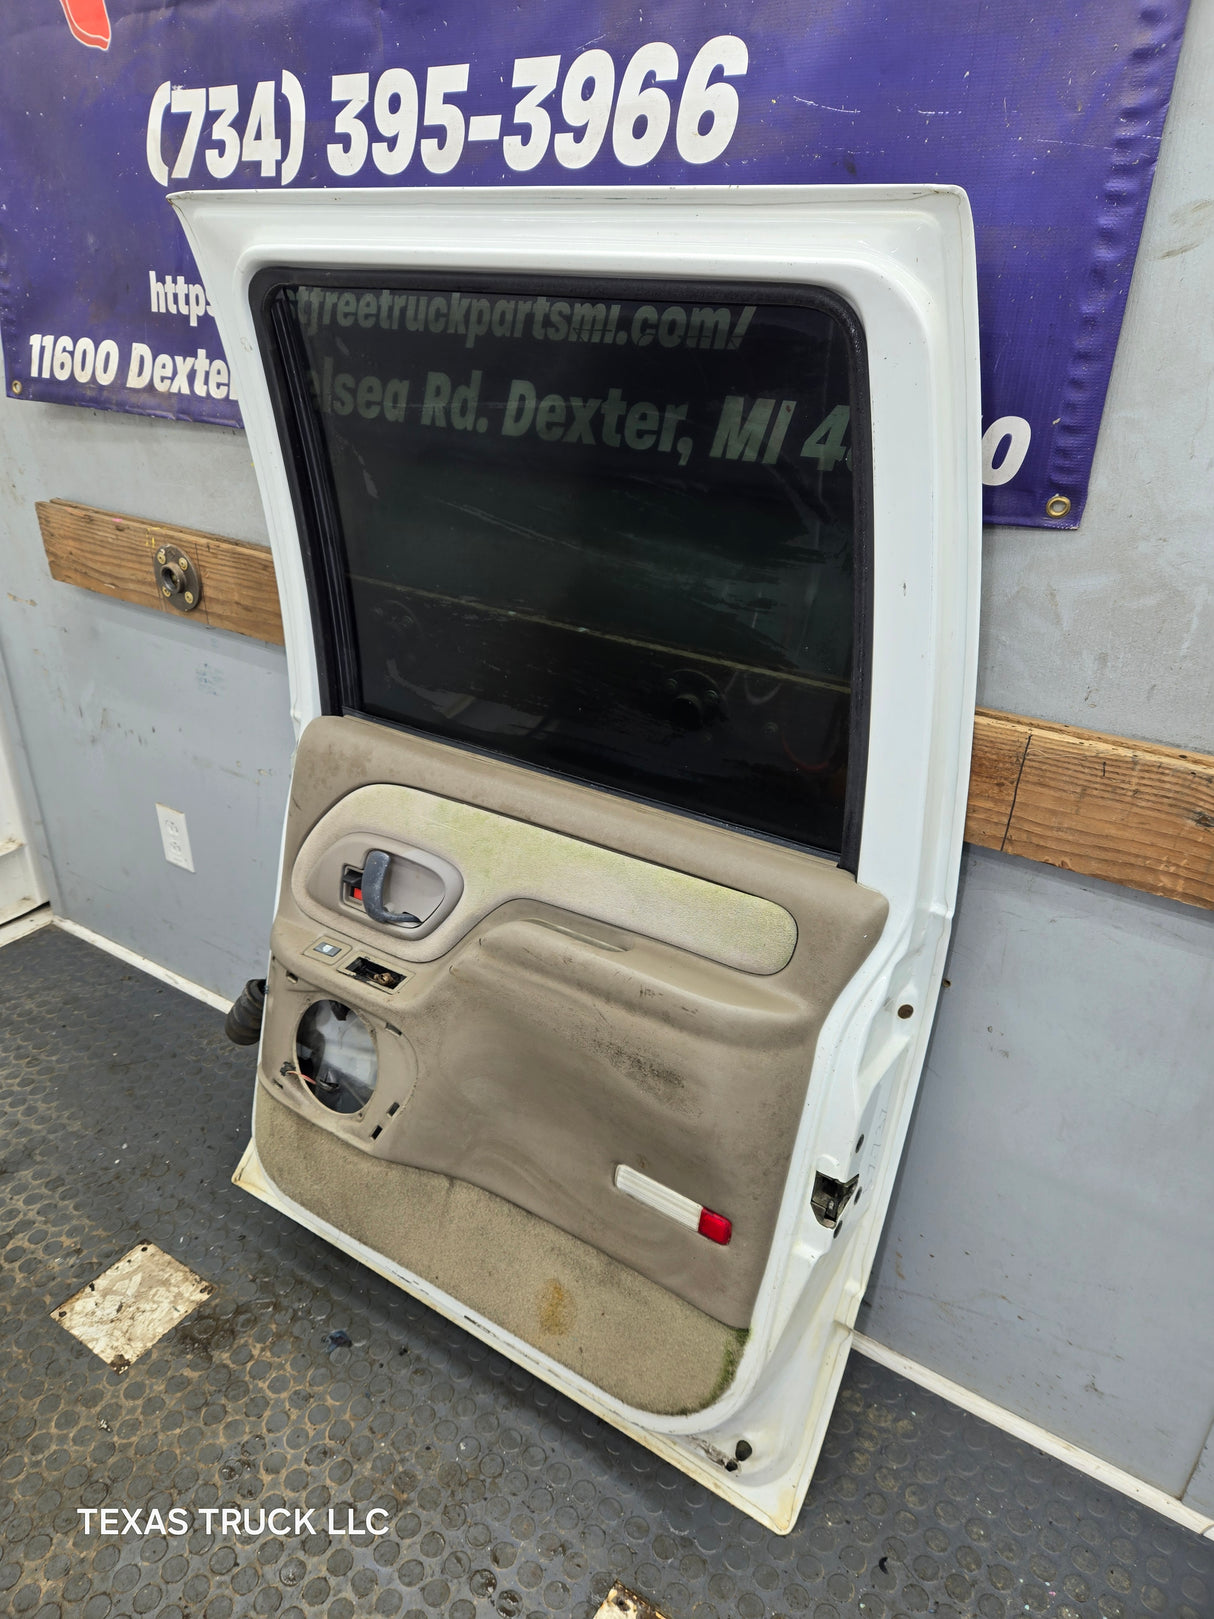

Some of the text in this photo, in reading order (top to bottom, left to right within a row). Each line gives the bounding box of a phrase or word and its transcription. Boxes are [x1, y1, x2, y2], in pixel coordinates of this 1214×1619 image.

[146, 35, 748, 187] (734) 395-3966
[29, 334, 119, 386] 11600
[420, 369, 489, 434] Rd.
[501, 379, 693, 466] Dexter,
[709, 395, 798, 465] MI
